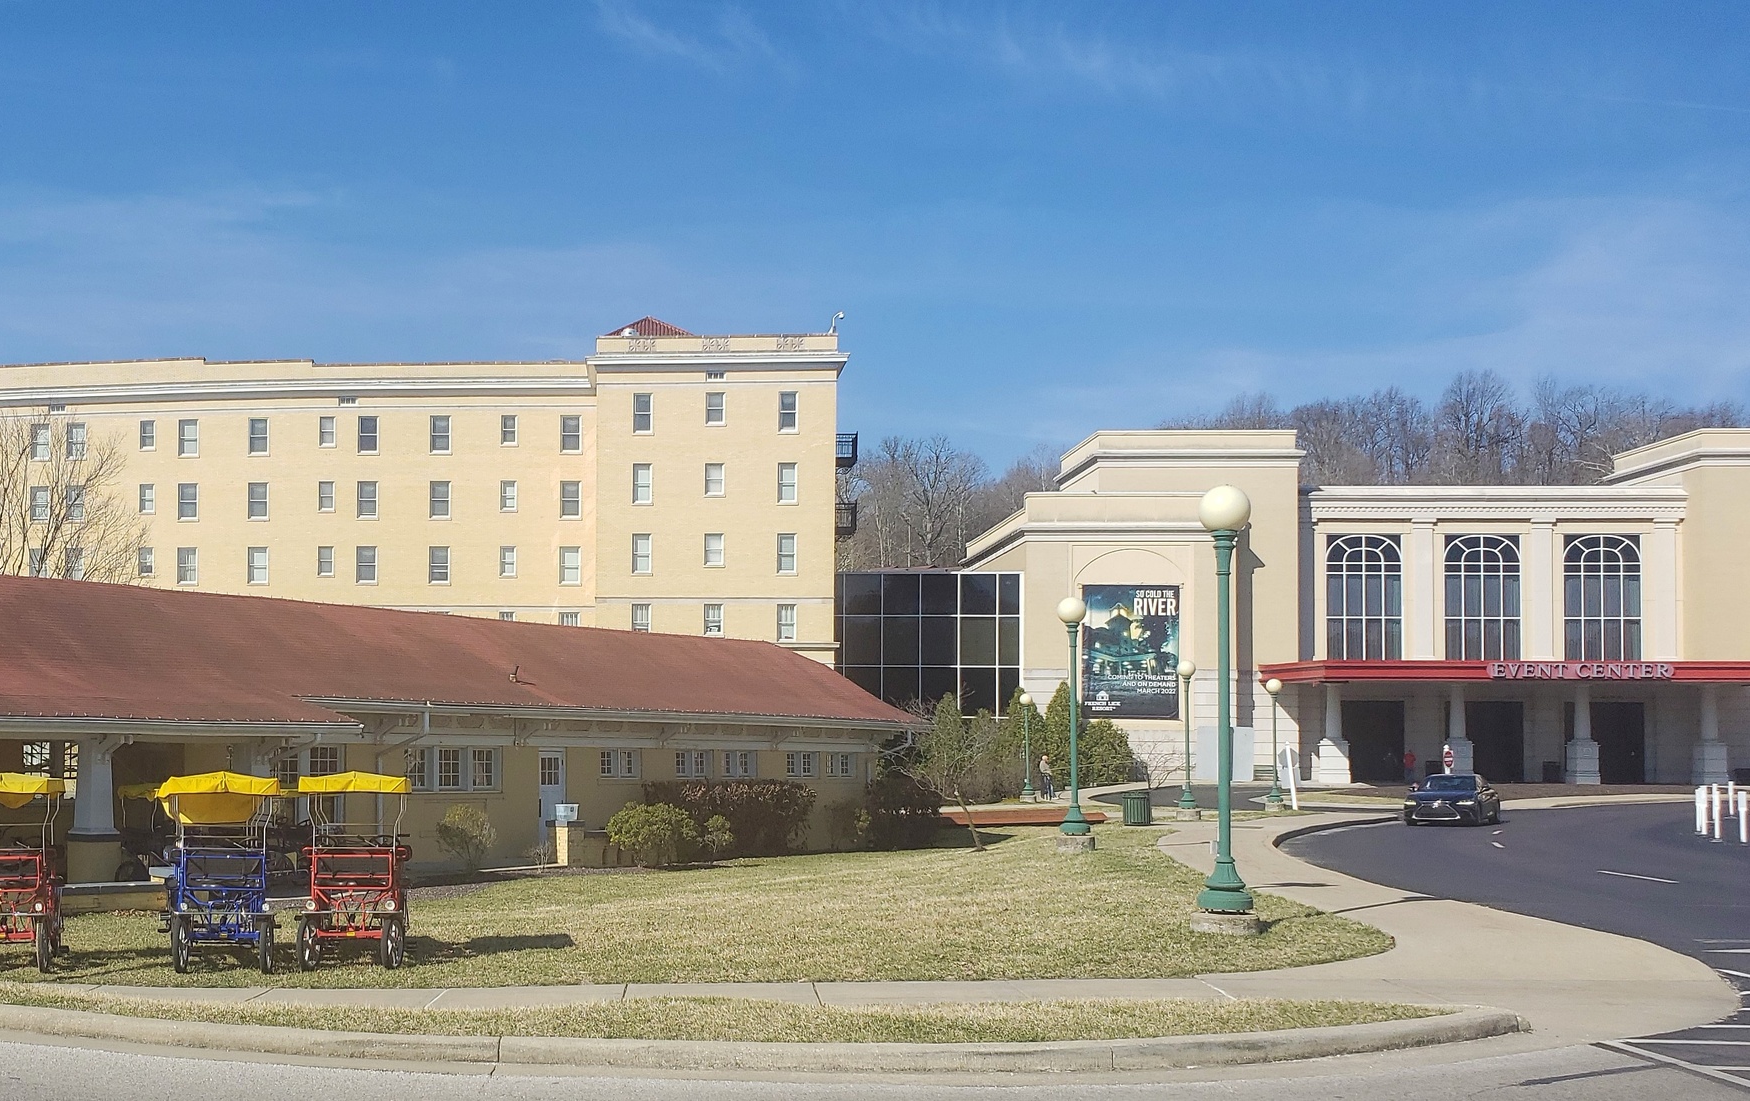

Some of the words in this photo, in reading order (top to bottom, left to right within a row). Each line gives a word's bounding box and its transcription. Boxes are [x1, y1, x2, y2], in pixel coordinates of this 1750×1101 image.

[1136, 590, 1144, 598] SO
[1145, 590, 1161, 598] COLD
[1162, 590, 1175, 598] THE
[1133, 598, 1177, 616] RIVER
[1493, 663, 1568, 678] EVENT
[1575, 663, 1670, 678] CENTER
